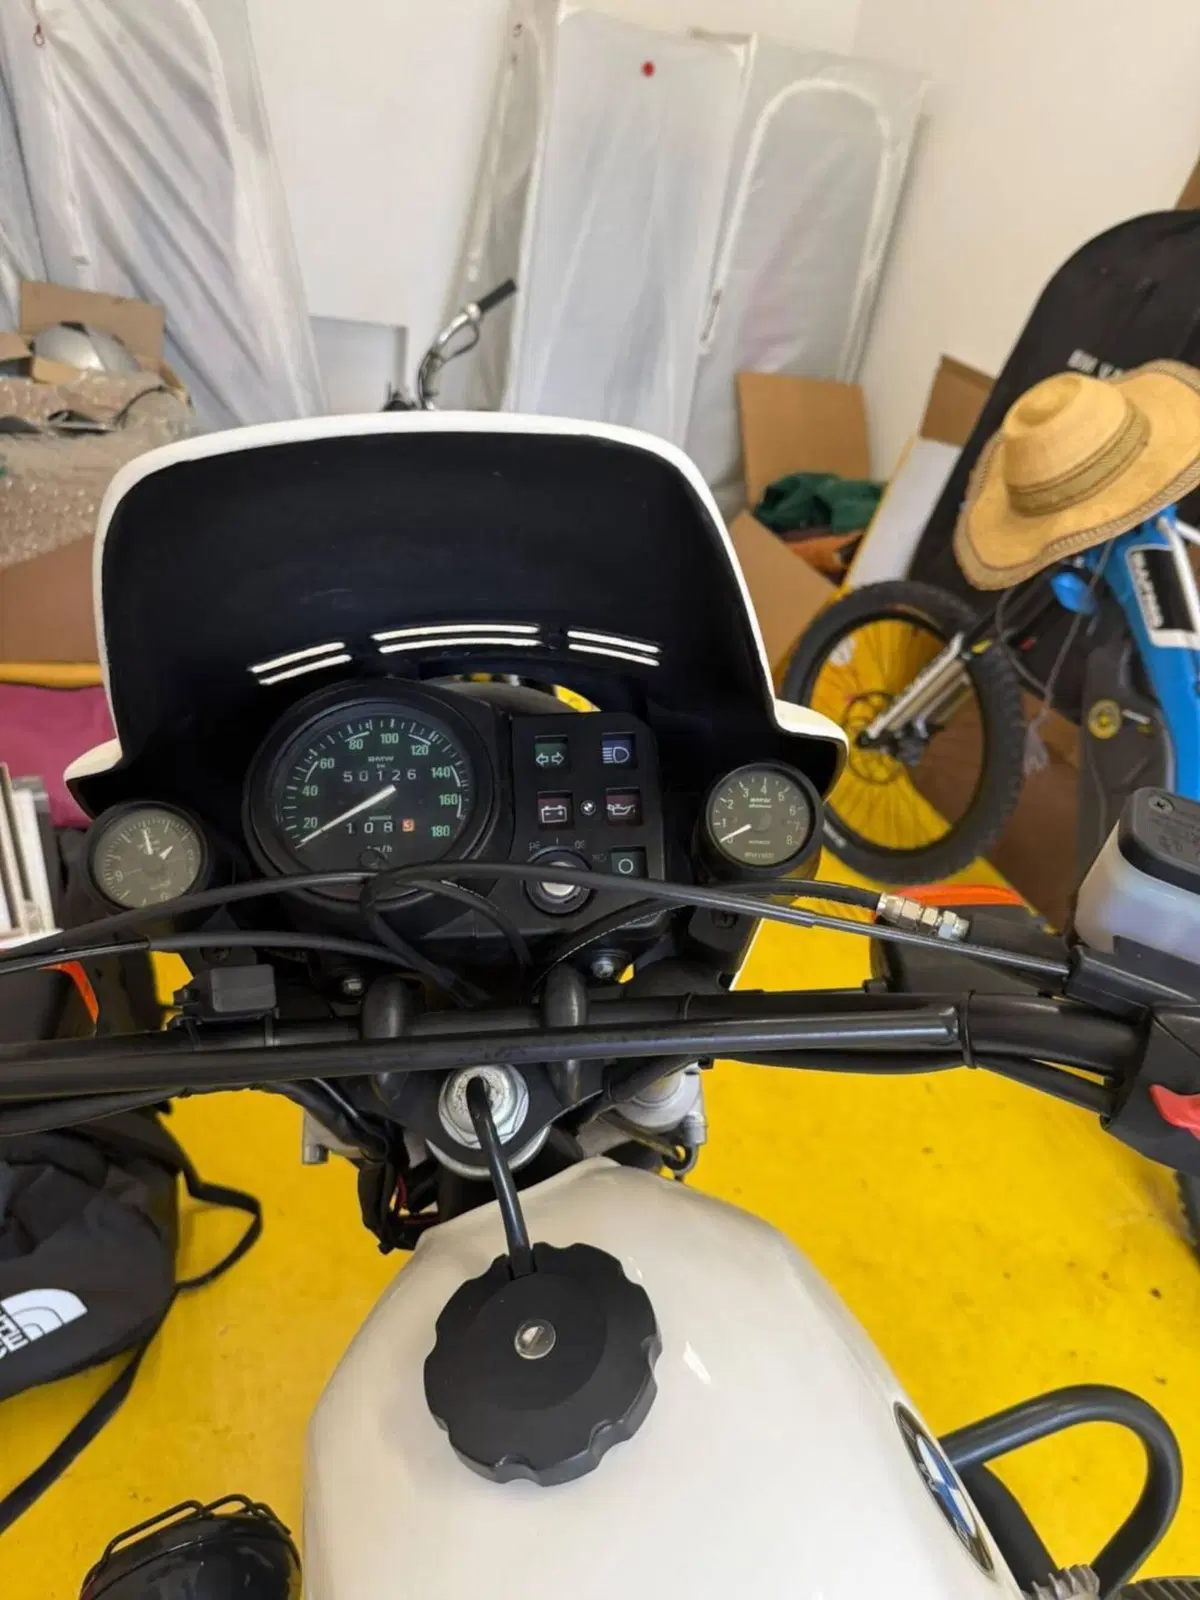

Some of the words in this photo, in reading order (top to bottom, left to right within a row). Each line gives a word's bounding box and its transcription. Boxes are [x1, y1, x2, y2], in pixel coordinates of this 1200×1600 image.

[348, 738, 364, 751] 80
[380, 732, 399, 745] 100
[411, 744, 429, 756] 120
[319, 758, 335, 770] 60
[343, 768, 417, 782] 50126
[431, 766, 451, 778] 140
[302, 787, 318, 798] 40
[743, 788, 749, 798] 3
[439, 794, 458, 806] 160
[727, 799, 734, 810] 2
[789, 806, 796, 816] 6
[303, 817, 318, 829] 20
[722, 818, 727, 828] 1
[431, 825, 450, 838] 180
[786, 835, 793, 846] 8
